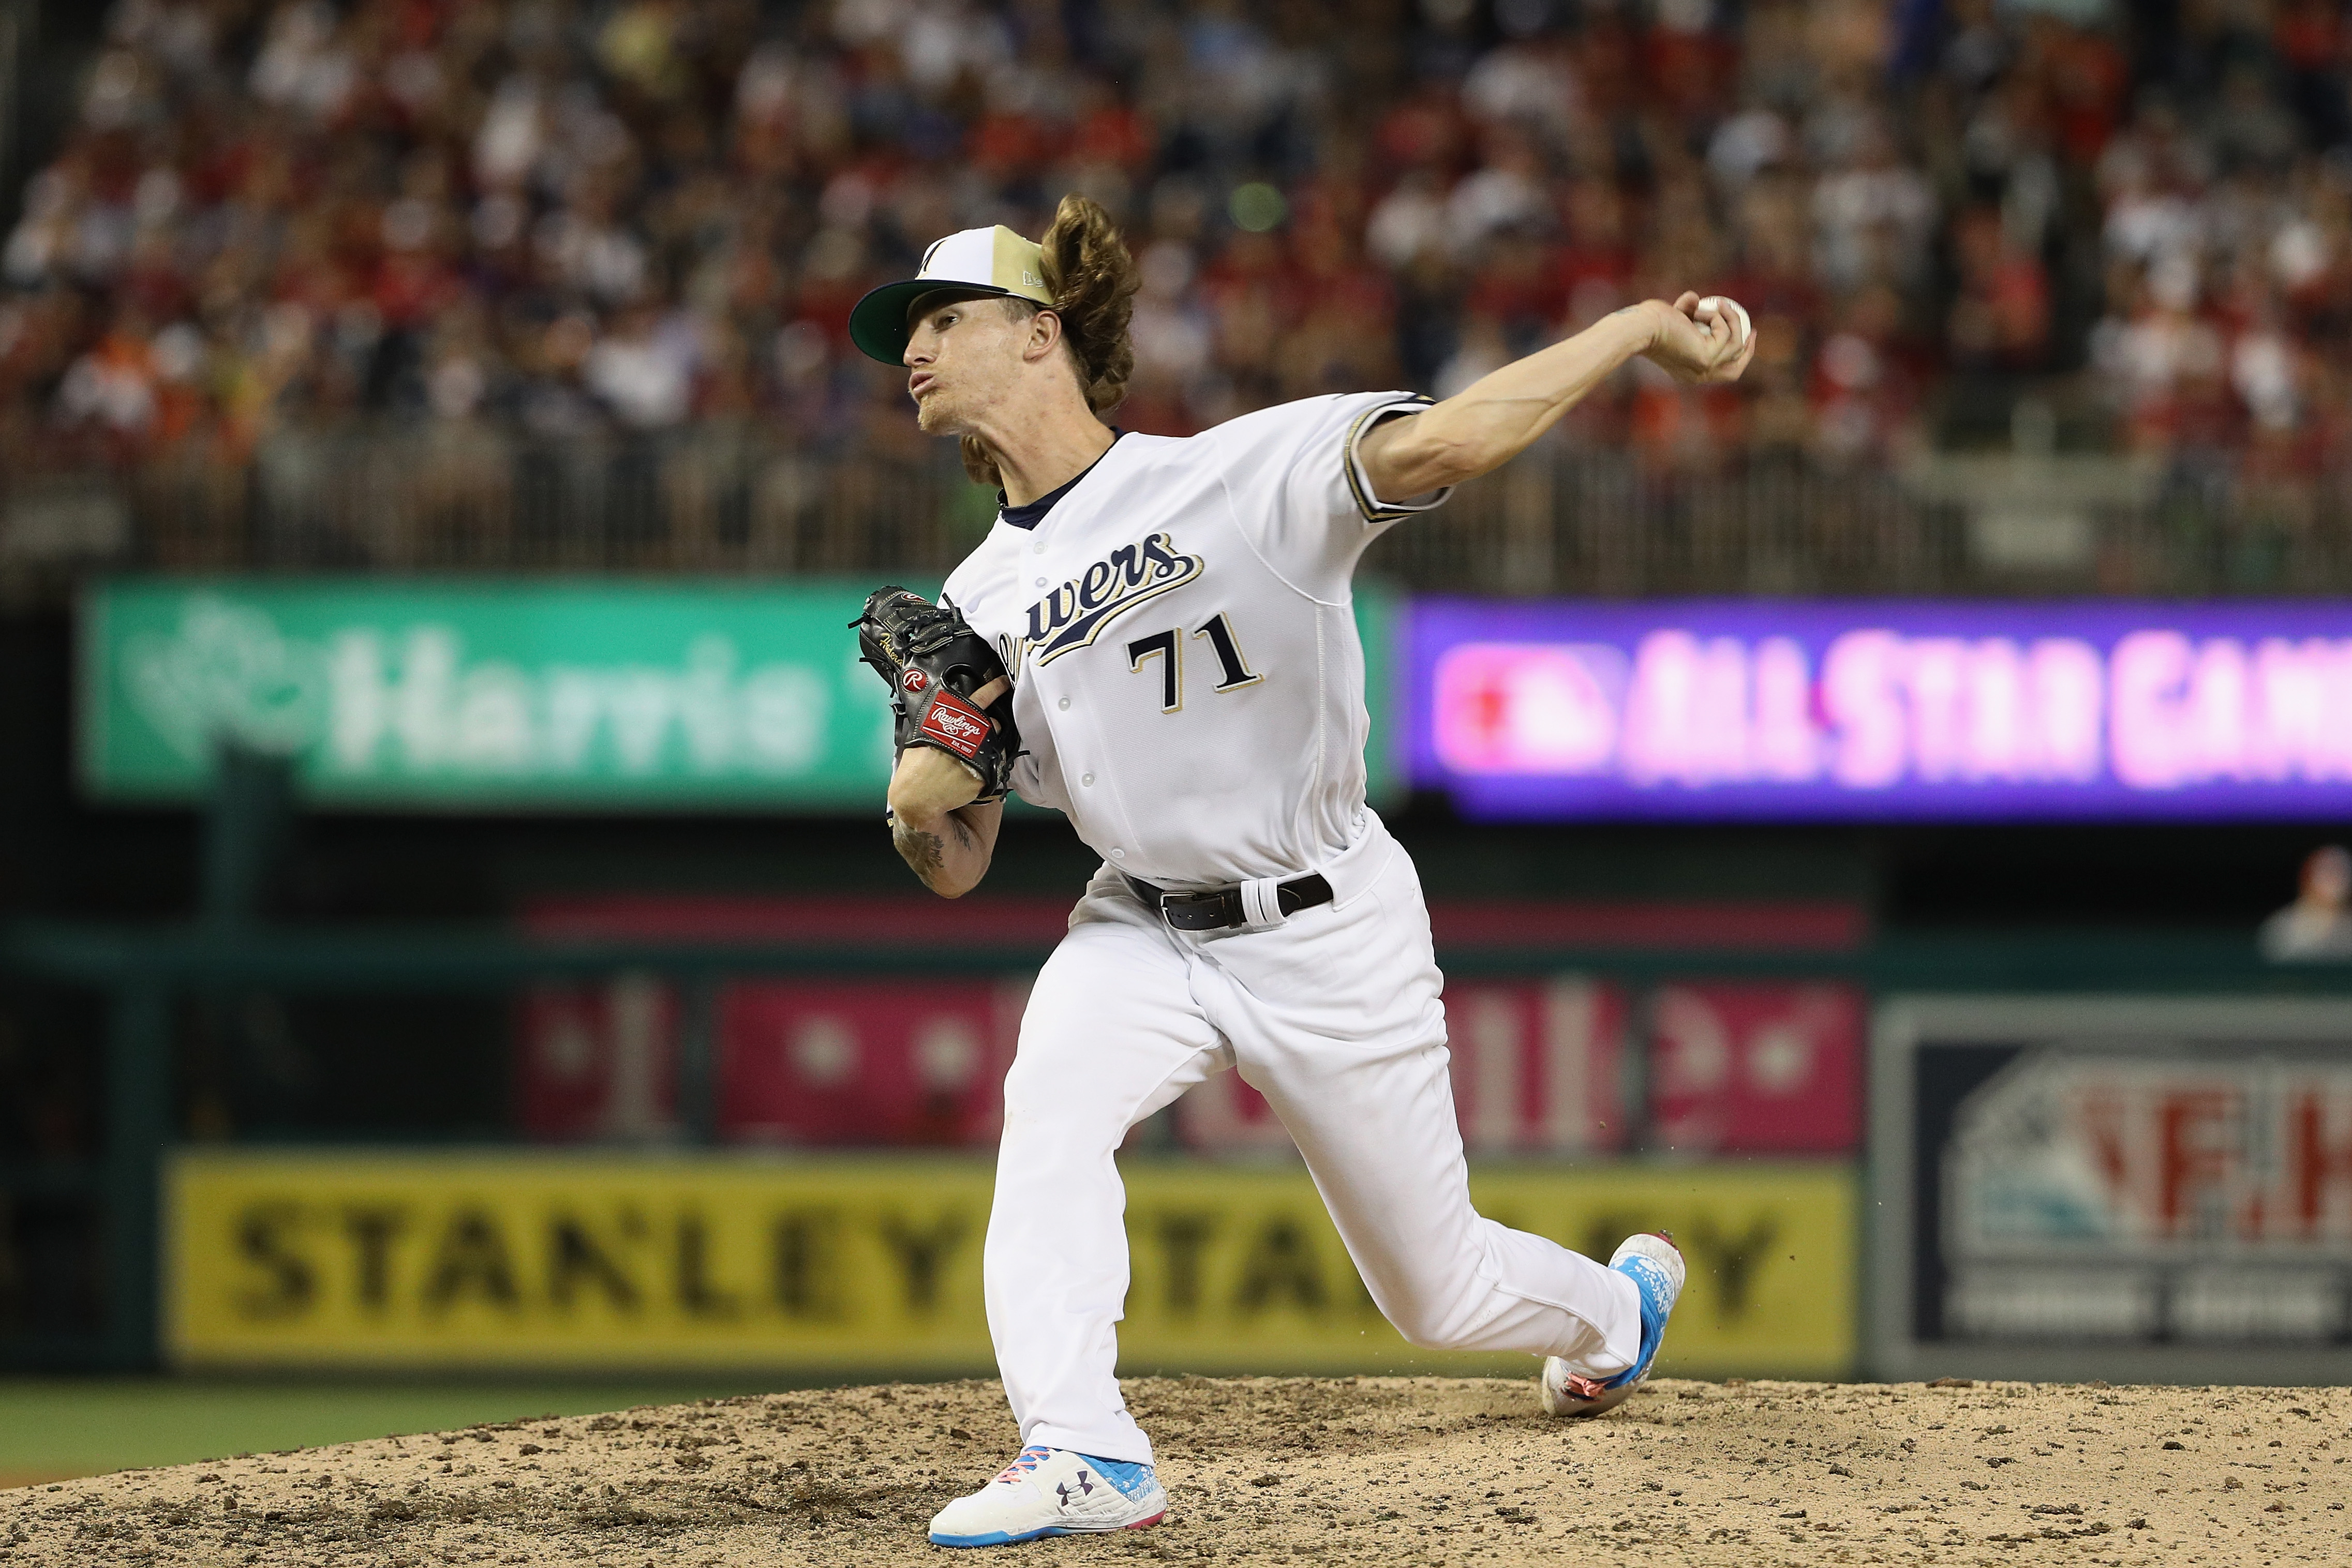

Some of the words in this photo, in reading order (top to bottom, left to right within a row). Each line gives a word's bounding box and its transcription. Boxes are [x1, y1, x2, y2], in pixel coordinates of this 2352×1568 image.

[999, 532, 1204, 688] wers
[903, 673, 922, 690] R
[1123, 612, 1266, 714] 71
[931, 706, 980, 737] Rawlings
[230, 1198, 972, 1322] STANLEY
